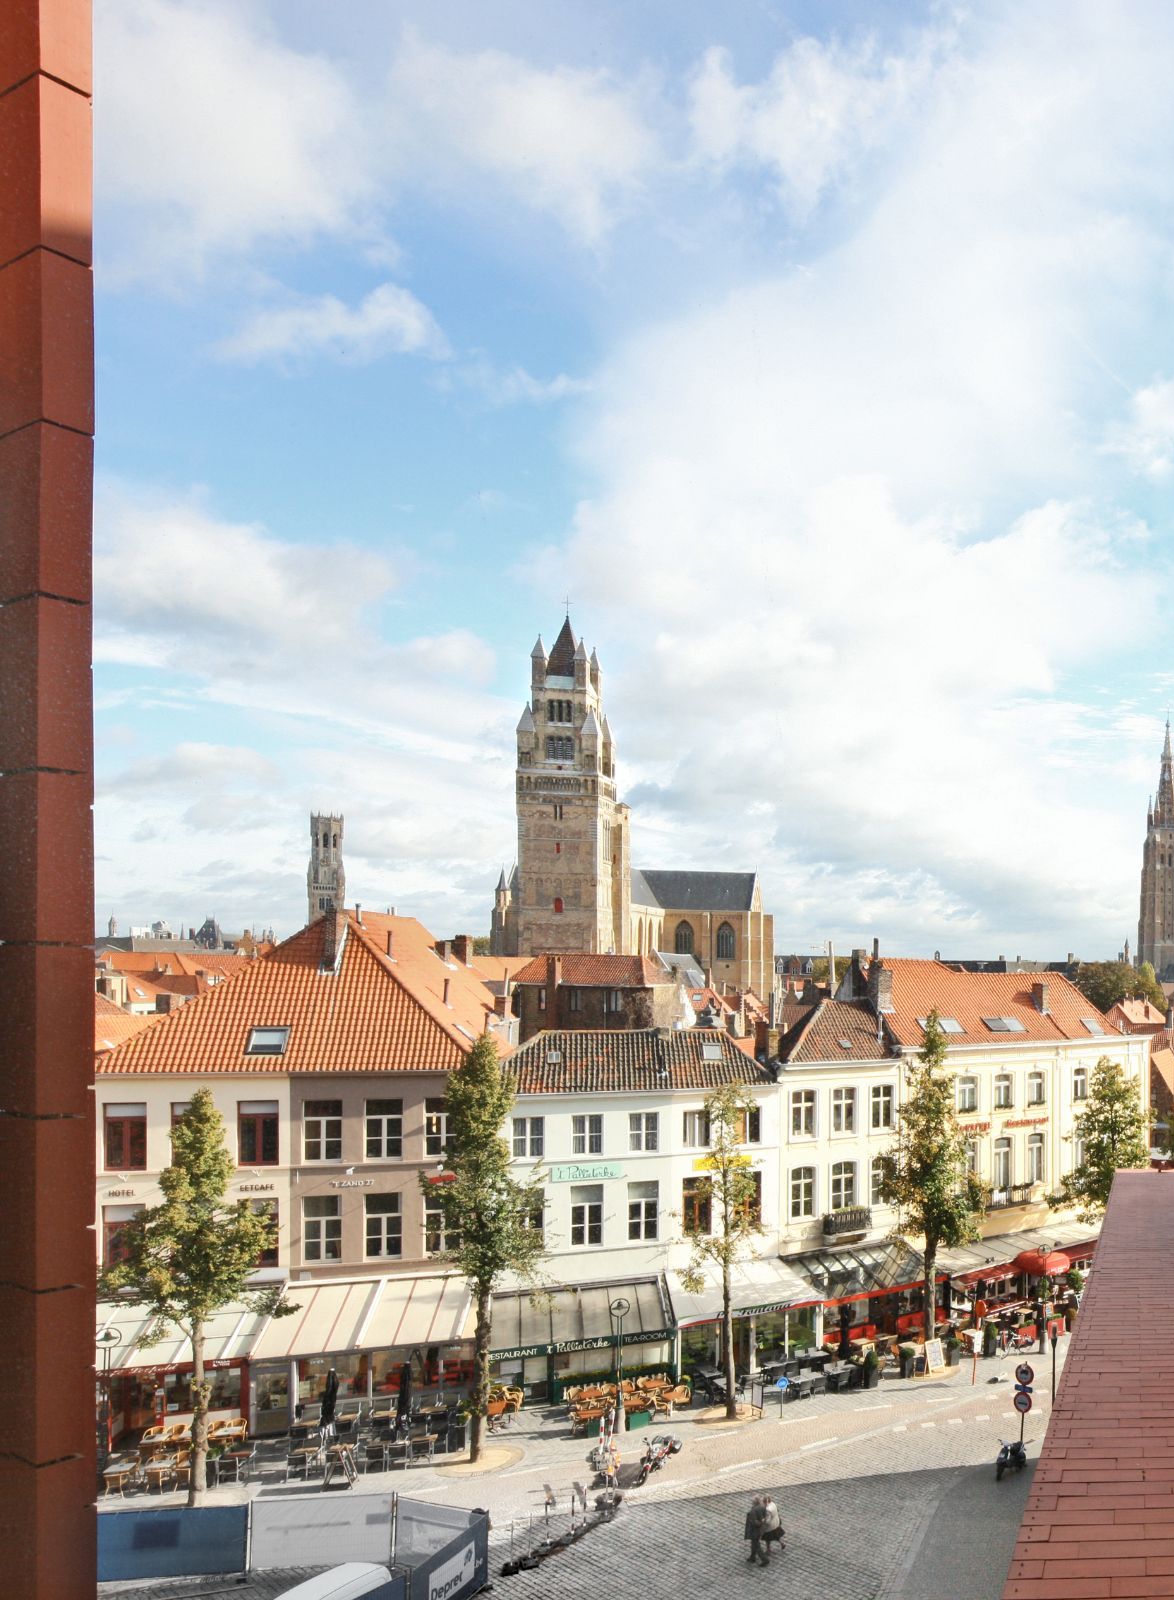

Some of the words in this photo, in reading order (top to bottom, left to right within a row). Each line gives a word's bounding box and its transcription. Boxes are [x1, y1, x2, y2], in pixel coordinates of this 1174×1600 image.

[108, 1189, 136, 1197] HOTEL
[239, 1183, 275, 1192] EETCAFE
[738, 1303, 792, 1316] Fontana
[554, 1338, 611, 1353] Pallieterke
[624, 1331, 667, 1343] TEA-ROOM
